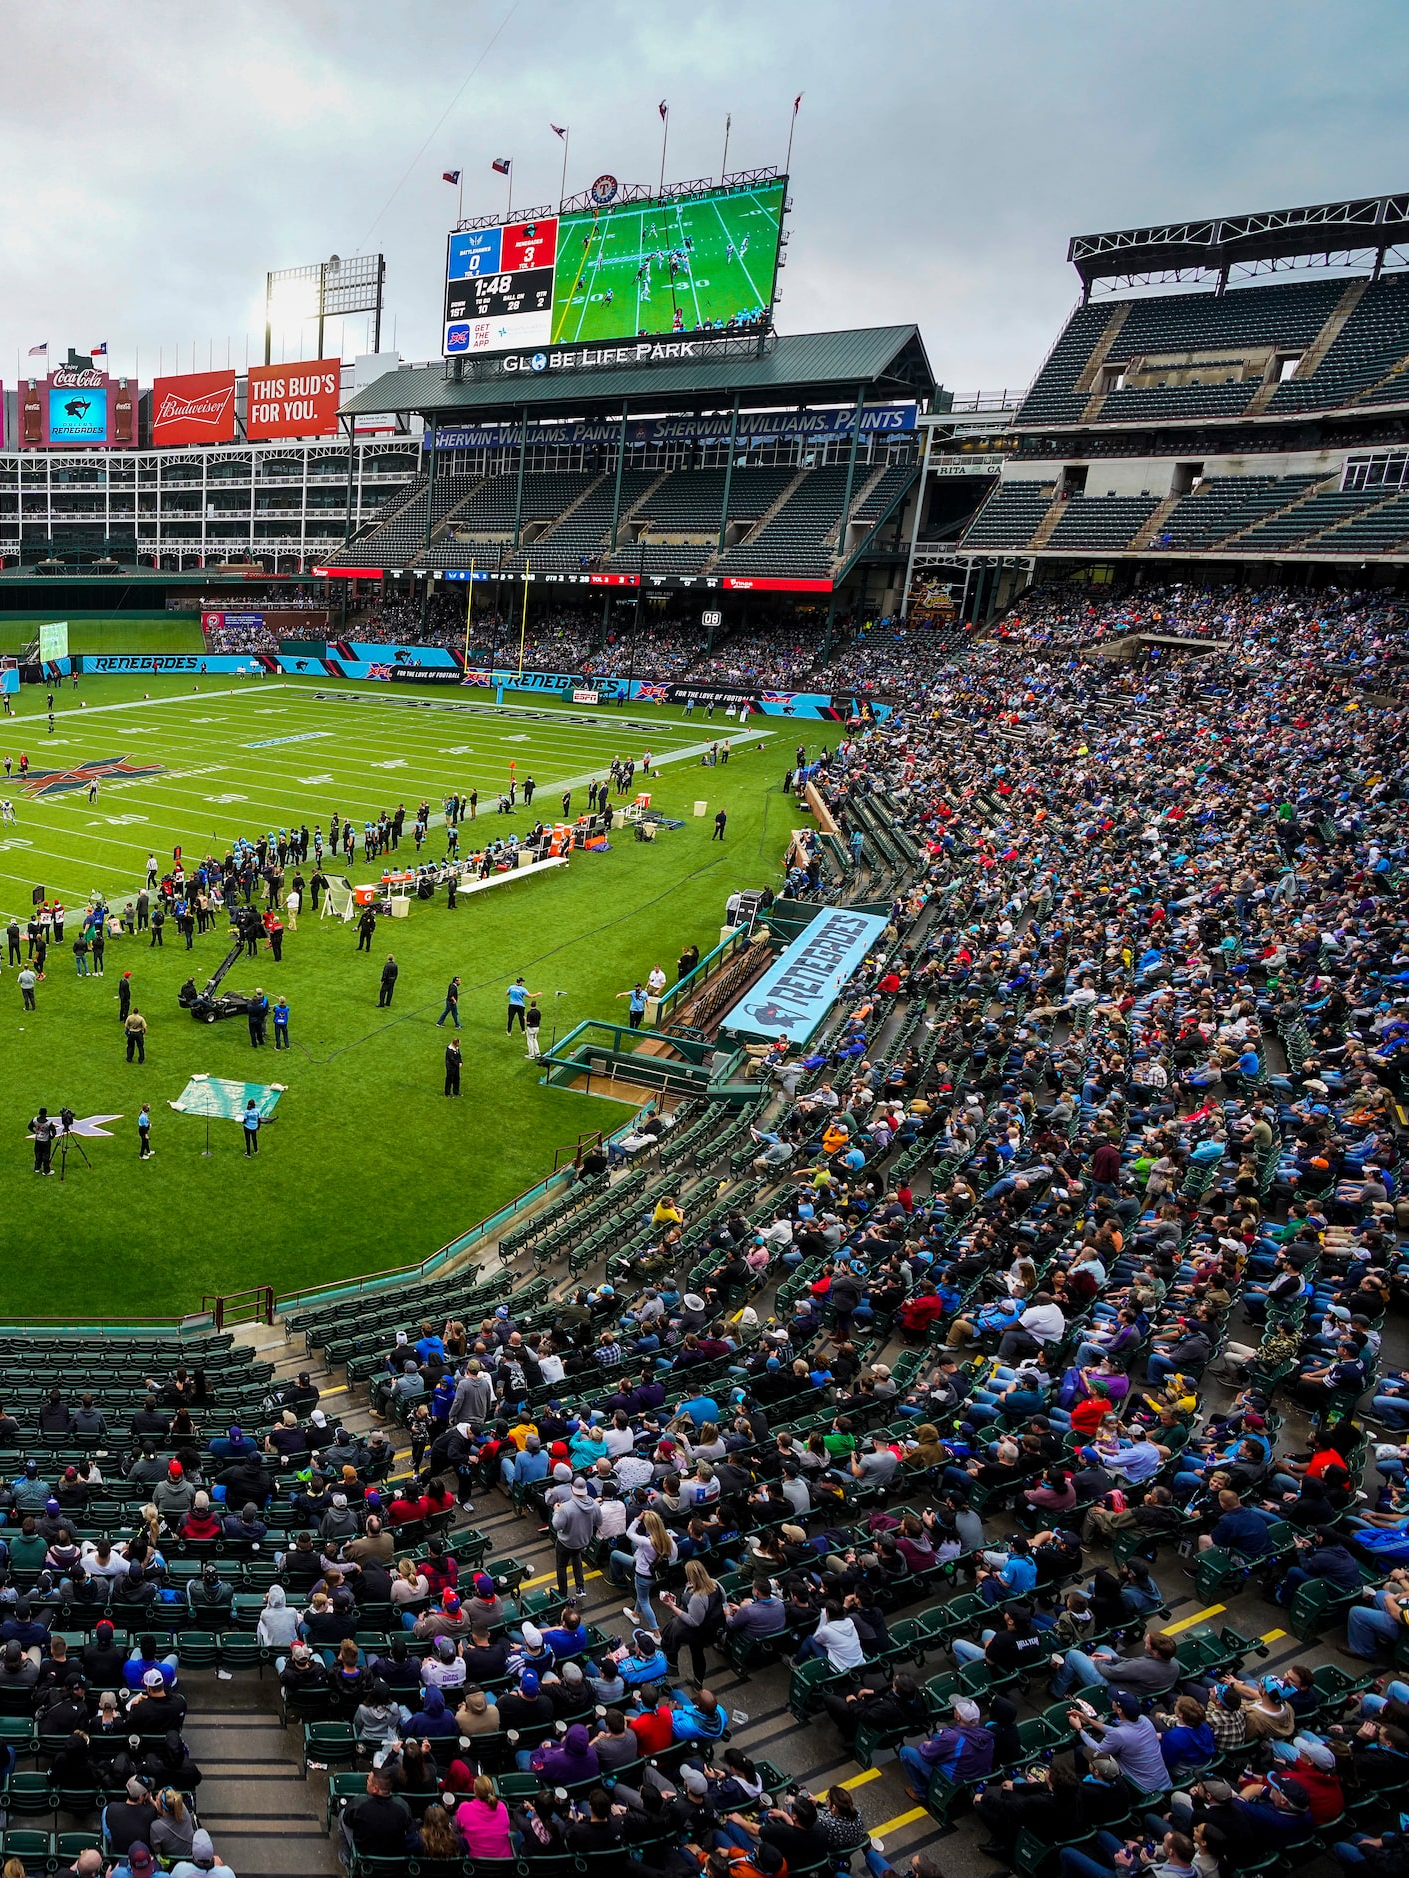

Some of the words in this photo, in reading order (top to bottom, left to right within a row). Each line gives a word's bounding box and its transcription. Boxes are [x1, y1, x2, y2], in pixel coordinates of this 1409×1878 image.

[523, 247, 535, 262] 3
[468, 255, 480, 270] 0
[474, 275, 512, 297] 1:48
[507, 301, 520, 311] 28
[537, 298, 544, 307] 2
[450, 307, 466, 318] 1ST
[478, 305, 488, 314] 10
[474, 324, 491, 332] GET
[475, 332, 490, 340] THE
[473, 340, 490, 348] APP
[503, 351, 576, 372] GLOBE
[581, 347, 628, 366] LIFE
[635, 341, 695, 361] PARK
[53, 369, 104, 388] Coca-Cola
[251, 381, 286, 401] THIS
[288, 373, 335, 397] BUD'S
[158, 399, 225, 418] Budweiser
[251, 404, 281, 424] FOR
[283, 400, 318, 420] YOU.
[52, 427, 104, 435] RENEGADES
[704, 613, 718, 624] 08
[95, 657, 198, 669] RENEGADES
[397, 670, 406, 678] FOR
[416, 671, 427, 679] LOVE
[436, 672, 460, 680] FOOTBALL
[574, 693, 597, 702] ESPN
[637, 686, 668, 698] XFL
[675, 690, 687, 698] FOR
[688, 691, 700, 699] THE
[700, 692, 713, 700] LOVE
[714, 693, 722, 701] OF
[106, 813, 149, 825] 40
[364, 892, 371, 901] G
[766, 914, 870, 1007] RENEGADES
[442, 1673, 459, 1682] DIGGS
